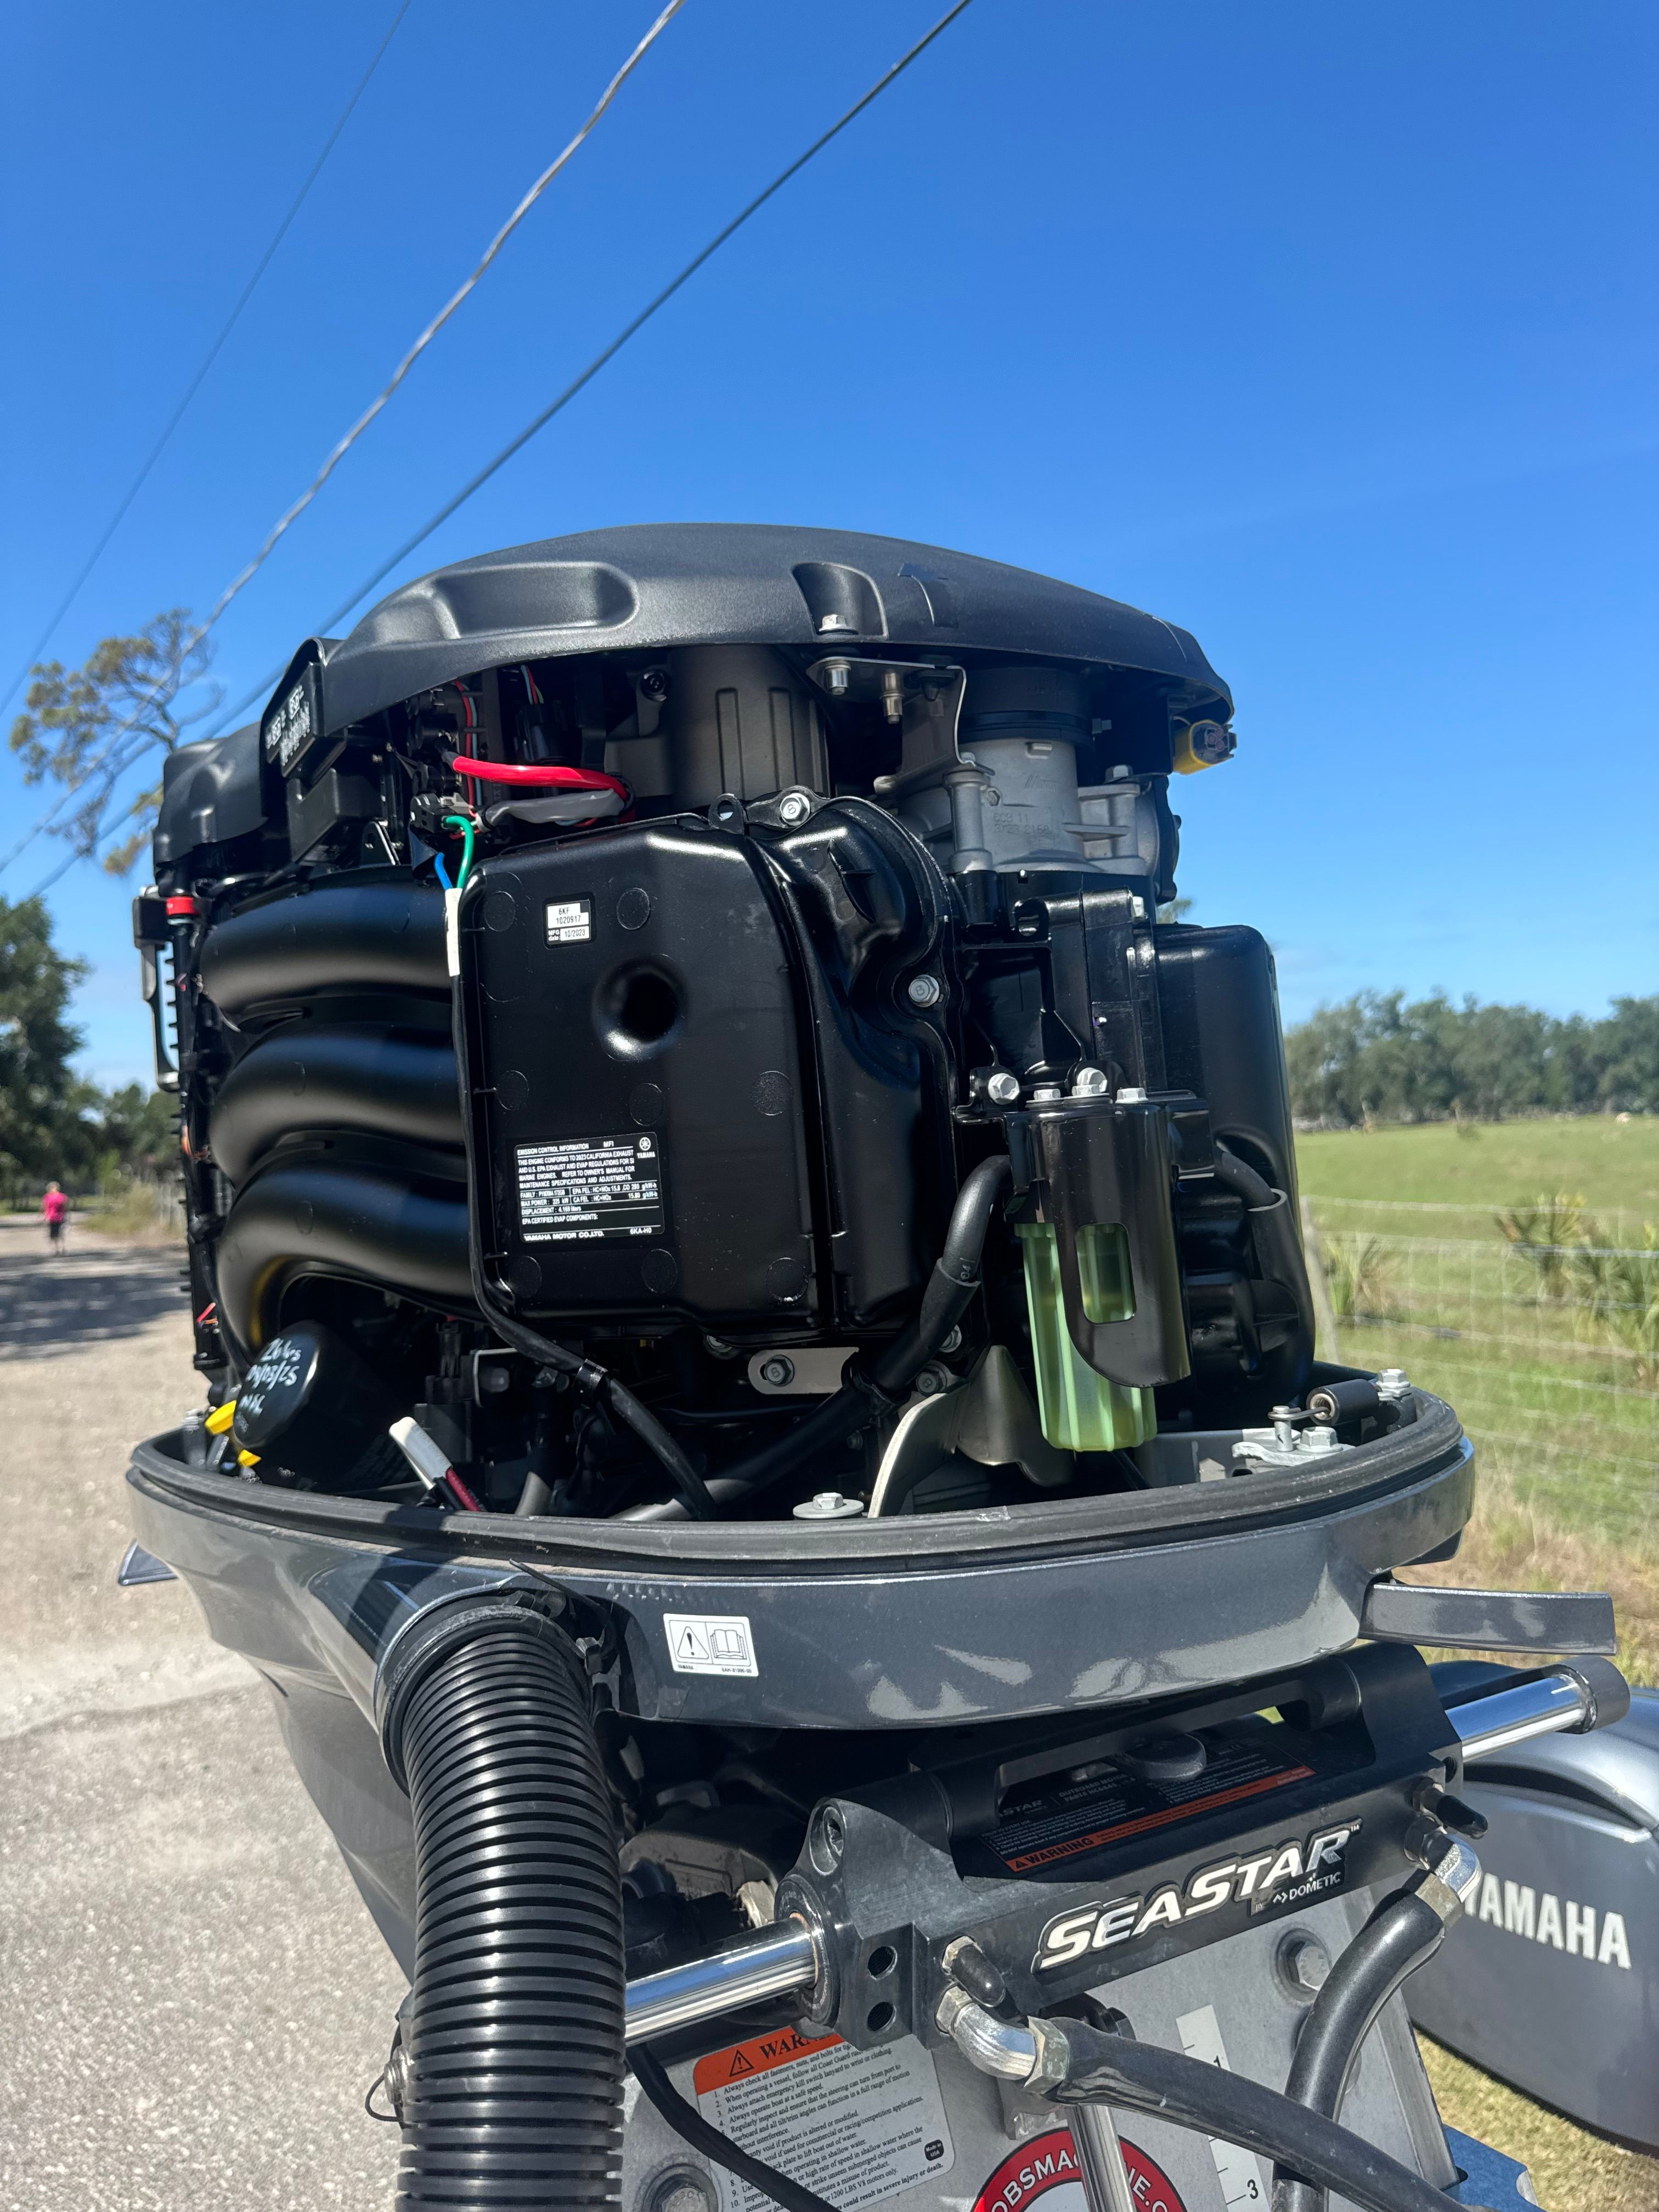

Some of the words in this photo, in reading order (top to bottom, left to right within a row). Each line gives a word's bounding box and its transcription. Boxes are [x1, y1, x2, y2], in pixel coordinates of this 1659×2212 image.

[556, 915, 581, 924] 1020917
[558, 907, 569, 915] 6KF
[565, 929, 585, 938] 10/2023
[538, 1146, 558, 1154] CONTROL
[558, 1143, 589, 1151] INFORMATION
[544, 1155, 569, 1163] CONFORMS
[588, 1159, 619, 1167] REGULATIONS
[519, 1180, 550, 1189] MAINTENANCE
[551, 1177, 586, 1186] SPECIFICATIONS
[599, 1173, 631, 1182] ADJUSTMENTS.
[566, 1213, 598, 1221] COMPONENTS:
[1025, 1837, 1095, 1864] WARNING
[1040, 1830, 1350, 1969] SEASTAR
[1289, 1871, 1342, 1901] DOMETIC
[724, 2083, 744, 2094] Always
[745, 2075, 761, 2086] check
[770, 2065, 794, 2076] fasteners,
[820, 2050, 833, 2058] bolts
[725, 2094, 742, 2103] When
[743, 2084, 768, 2097] operating
[774, 2074, 791, 2085] vessel,
[792, 2069, 809, 2079] follow
[818, 2059, 833, 2068] Coast
[834, 2052, 850, 2063] Guard
[727, 2102, 747, 2113] Always
[749, 2095, 765, 2105] attach
[766, 2085, 794, 2098] emergency
[795, 2079, 804, 2087] kill
[806, 2073, 823, 2084] switch
[823, 2065, 843, 2076] lanyard
[850, 2058, 863, 2066] wrist
[871, 2048, 892, 2059] clothing.
[730, 2112, 749, 2123] Always
[751, 2104, 770, 2115] operate
[771, 2098, 783, 2107] boat
[795, 2089, 805, 2098] safe
[807, 2083, 823, 2094] speed.
[731, 2119, 757, 2132] Regularly
[759, 2111, 777, 2122] inspect
[789, 2101, 806, 2110] ensure
[828, 2085, 848, 2095] steering
[871, 2071, 883, 2079] from
[884, 2066, 894, 2076] port
[778, 2114, 798, 2125] tilt/trim
[799, 2107, 816, 2117] angles
[828, 2095, 849, 2106] function
[860, 2085, 870, 2093] full
[871, 2080, 884, 2089] range
[892, 2071, 910, 2081] motion
[757, 2129, 789, 2143] interference.
[763, 2142, 775, 2151] void
[781, 2133, 802, 2147] product
[809, 2122, 826, 2134] altered
[834, 2110, 858, 2124] modified.
[764, 2152, 776, 2161] void
[783, 2145, 795, 2154] used
[806, 2129, 836, 2145] commercial
[844, 2109, 891, 2130] racing/competition
[893, 2096, 923, 2112] applications.
[783, 2157, 795, 2167] plate
[804, 2149, 812, 2157] lift
[812, 2145, 825, 2153] boat
[842, 2132, 857, 2141] water.
[794, 2158, 820, 2172] operating
[828, 2146, 848, 2158] shallow
[850, 2140, 866, 2148] water.
[805, 2168, 817, 2177] high
[838, 2153, 853, 2165] speed
[861, 2143, 880, 2155] shallow
[882, 2137, 896, 2146] water
[898, 2130, 913, 2140] where
[812, 2176, 826, 2186] strike
[828, 2168, 847, 2179] unseen
[848, 2154, 876, 2171] submerged
[878, 2148, 896, 2158] objects
[907, 2137, 921, 2146] cause
[831, 2189, 843, 2199] 1200
[844, 2183, 856, 2193] LBS
[867, 2174, 884, 2184] motors
[841, 2173, 859, 2184] misuse
[868, 2161, 889, 2175] product.
[843, 2197, 858, 2207] could
[860, 2190, 875, 2200] result
[883, 2181, 900, 2191] severe
[901, 2173, 917, 2183] injury
[927, 2163, 943, 2172] death.
[1247, 2179, 1259, 2199] 3
